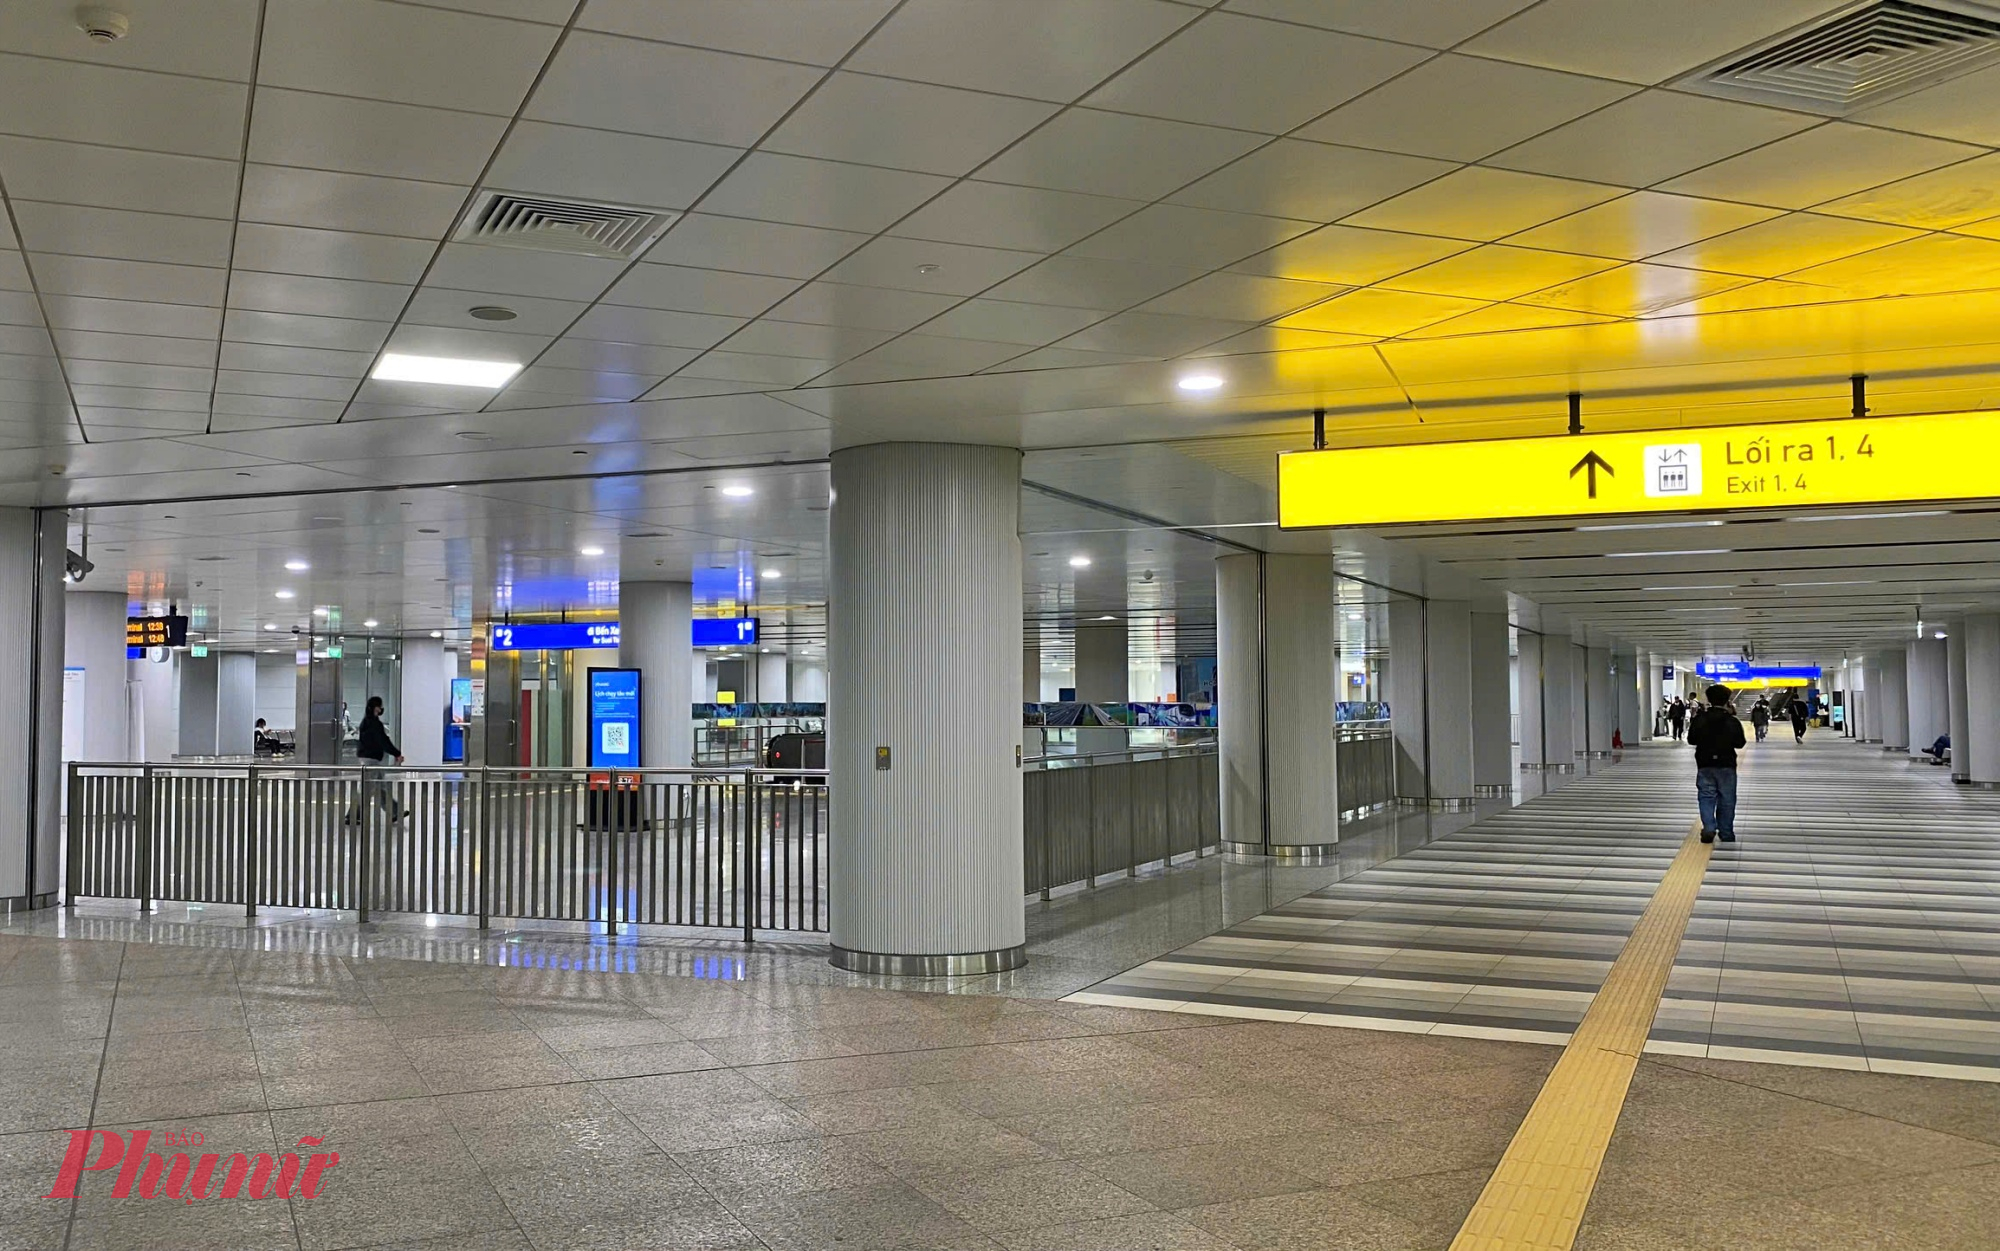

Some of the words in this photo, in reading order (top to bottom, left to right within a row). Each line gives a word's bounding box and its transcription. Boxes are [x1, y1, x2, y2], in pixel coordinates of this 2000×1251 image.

[1726, 435, 1770, 465] Lối
[1783, 443, 1813, 463] ra
[1826, 435, 1845, 461] 1,
[1856, 433, 1874, 458] 4
[1727, 475, 1765, 494] Exit
[1795, 473, 1807, 490] 4
[502, 629, 512, 646] 2
[737, 622, 744, 640] 1
